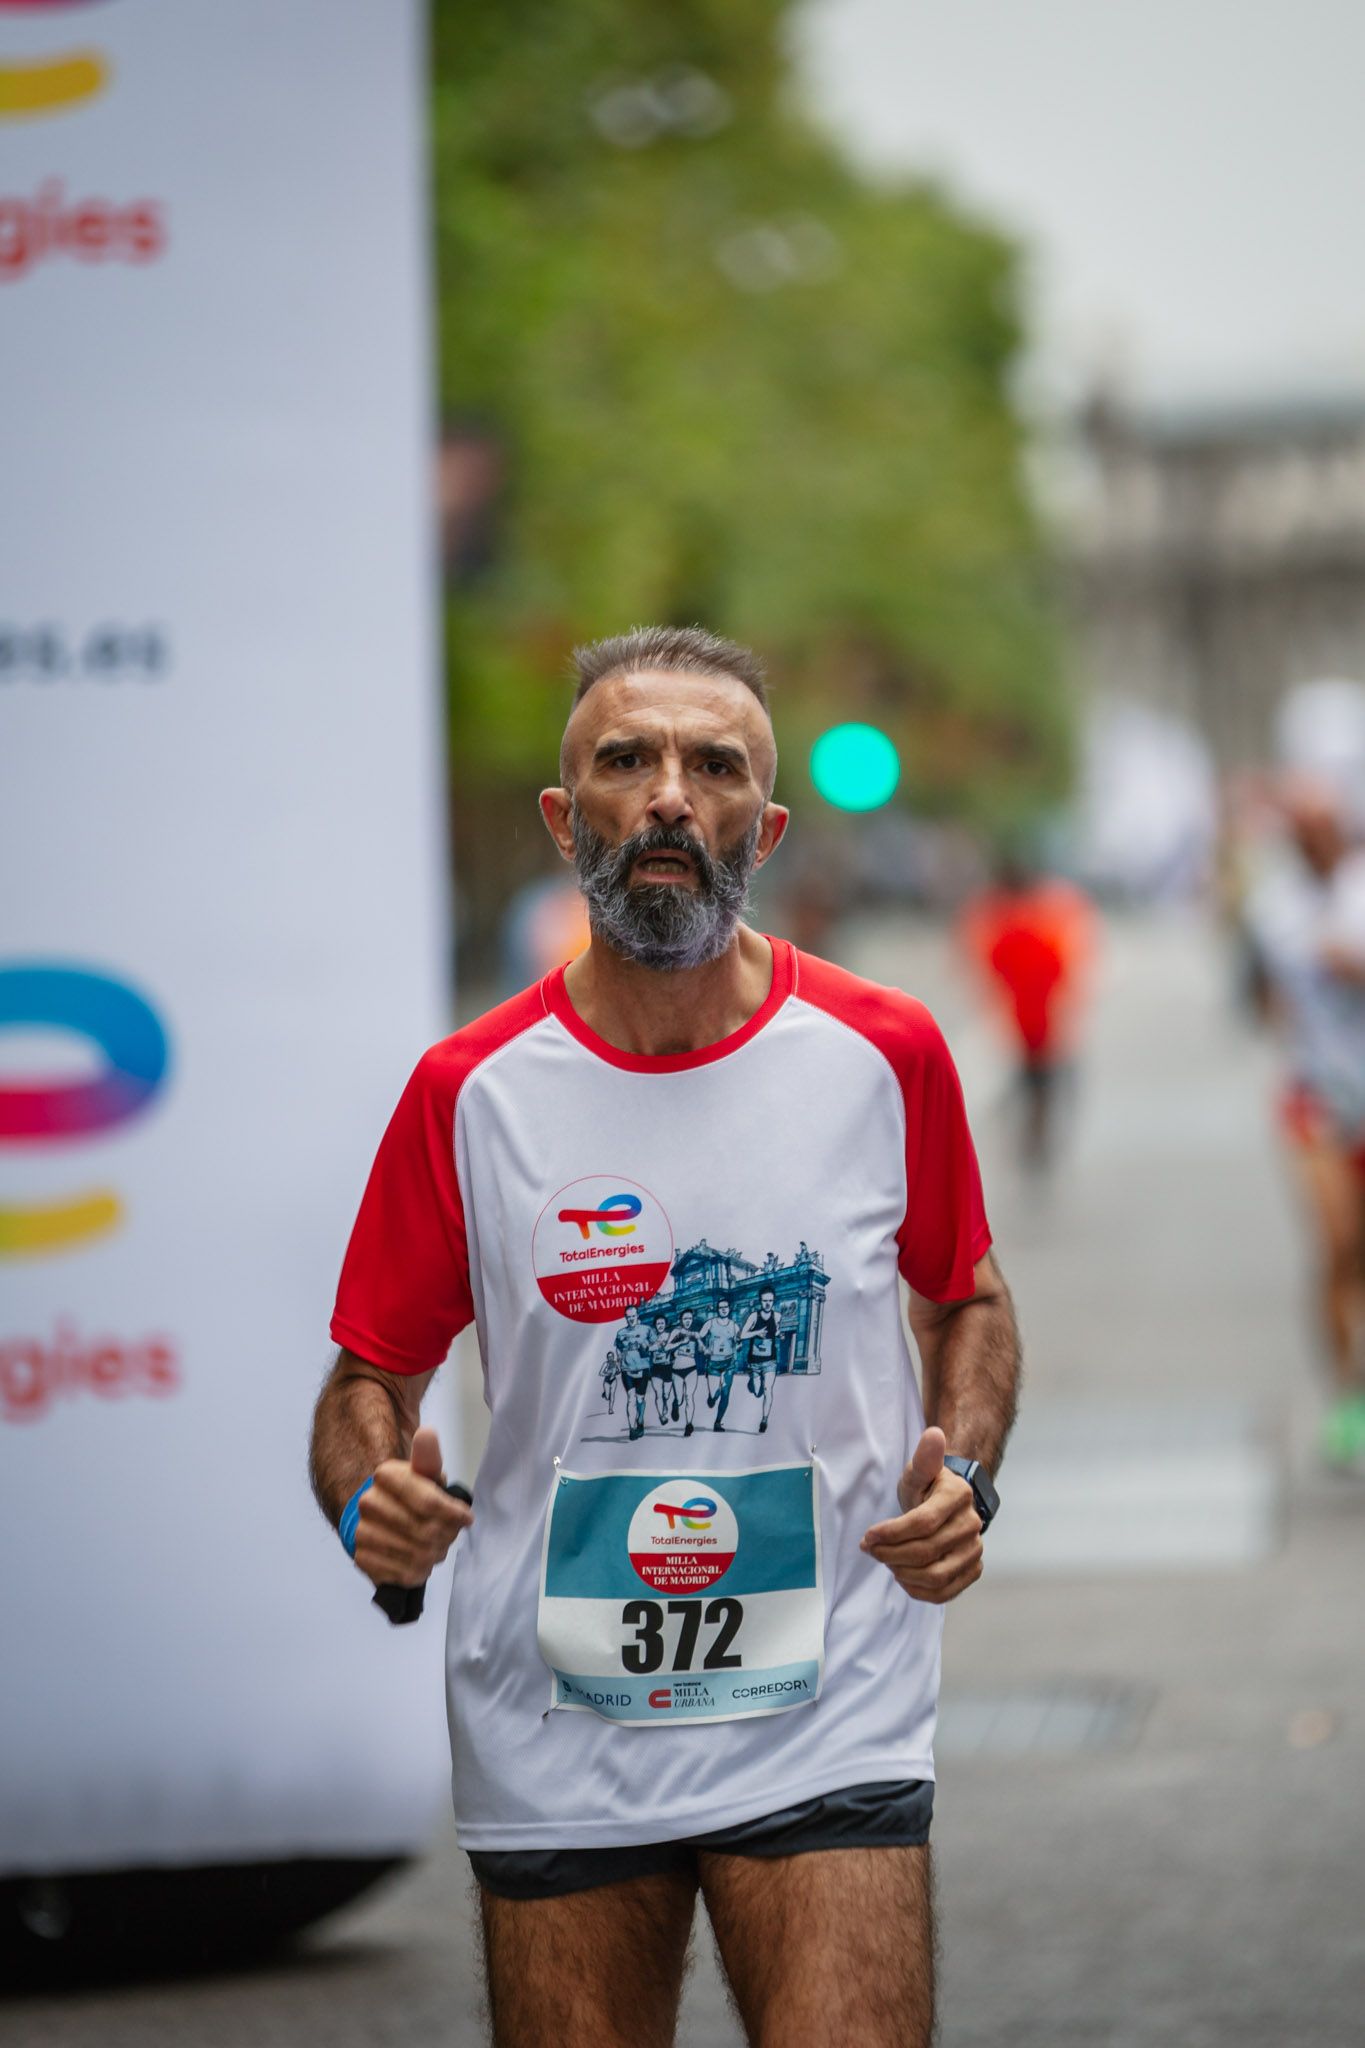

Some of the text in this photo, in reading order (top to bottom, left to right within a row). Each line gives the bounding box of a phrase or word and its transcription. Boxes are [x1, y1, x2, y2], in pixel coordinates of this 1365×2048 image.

[560, 1243, 645, 1263] TotalEnergies
[581, 1271, 621, 1286] MILLA
[569, 1297, 638, 1314] DE MADRID
[650, 1535, 718, 1547] TotalEnergies
[666, 1556, 698, 1565] MILLA
[653, 1575, 710, 1586] DE MADRID
[621, 1597, 744, 1674] 372
[674, 1688, 709, 1697] MILLA
[674, 1697, 715, 1708] URBANA
